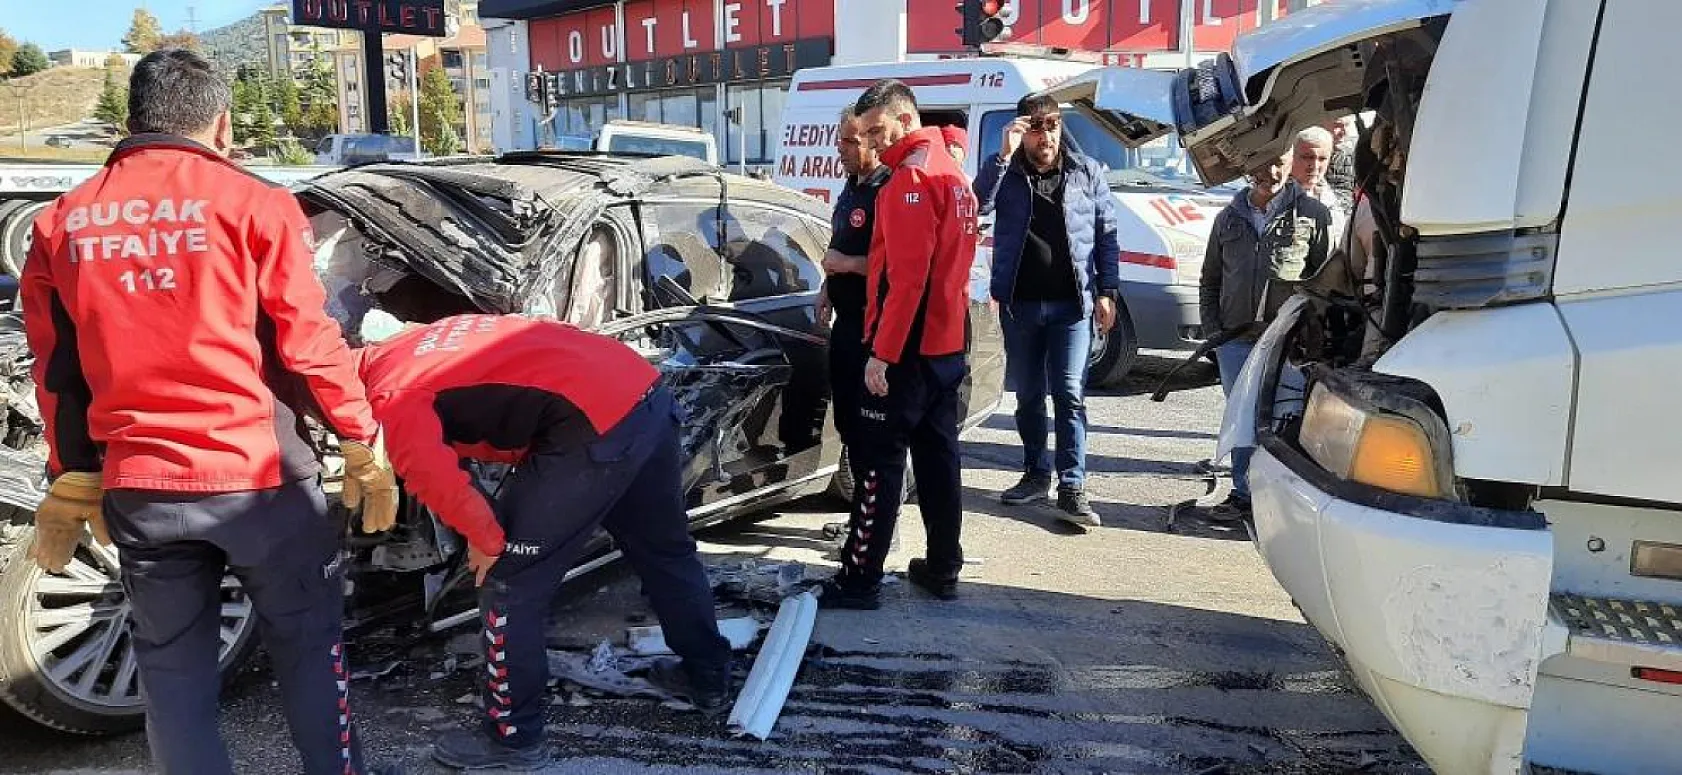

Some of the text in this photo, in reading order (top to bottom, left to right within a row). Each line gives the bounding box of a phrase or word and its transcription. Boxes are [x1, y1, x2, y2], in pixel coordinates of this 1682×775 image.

[568, 0, 786, 63] OUTLET
[665, 43, 795, 85] OUTLET
[980, 71, 1005, 87] 112
[905, 192, 919, 204] 112
[1149, 198, 1206, 226] 112
[65, 198, 210, 232] BUCAK
[68, 227, 208, 263] İTFAİYE
[120, 268, 176, 293] 112
